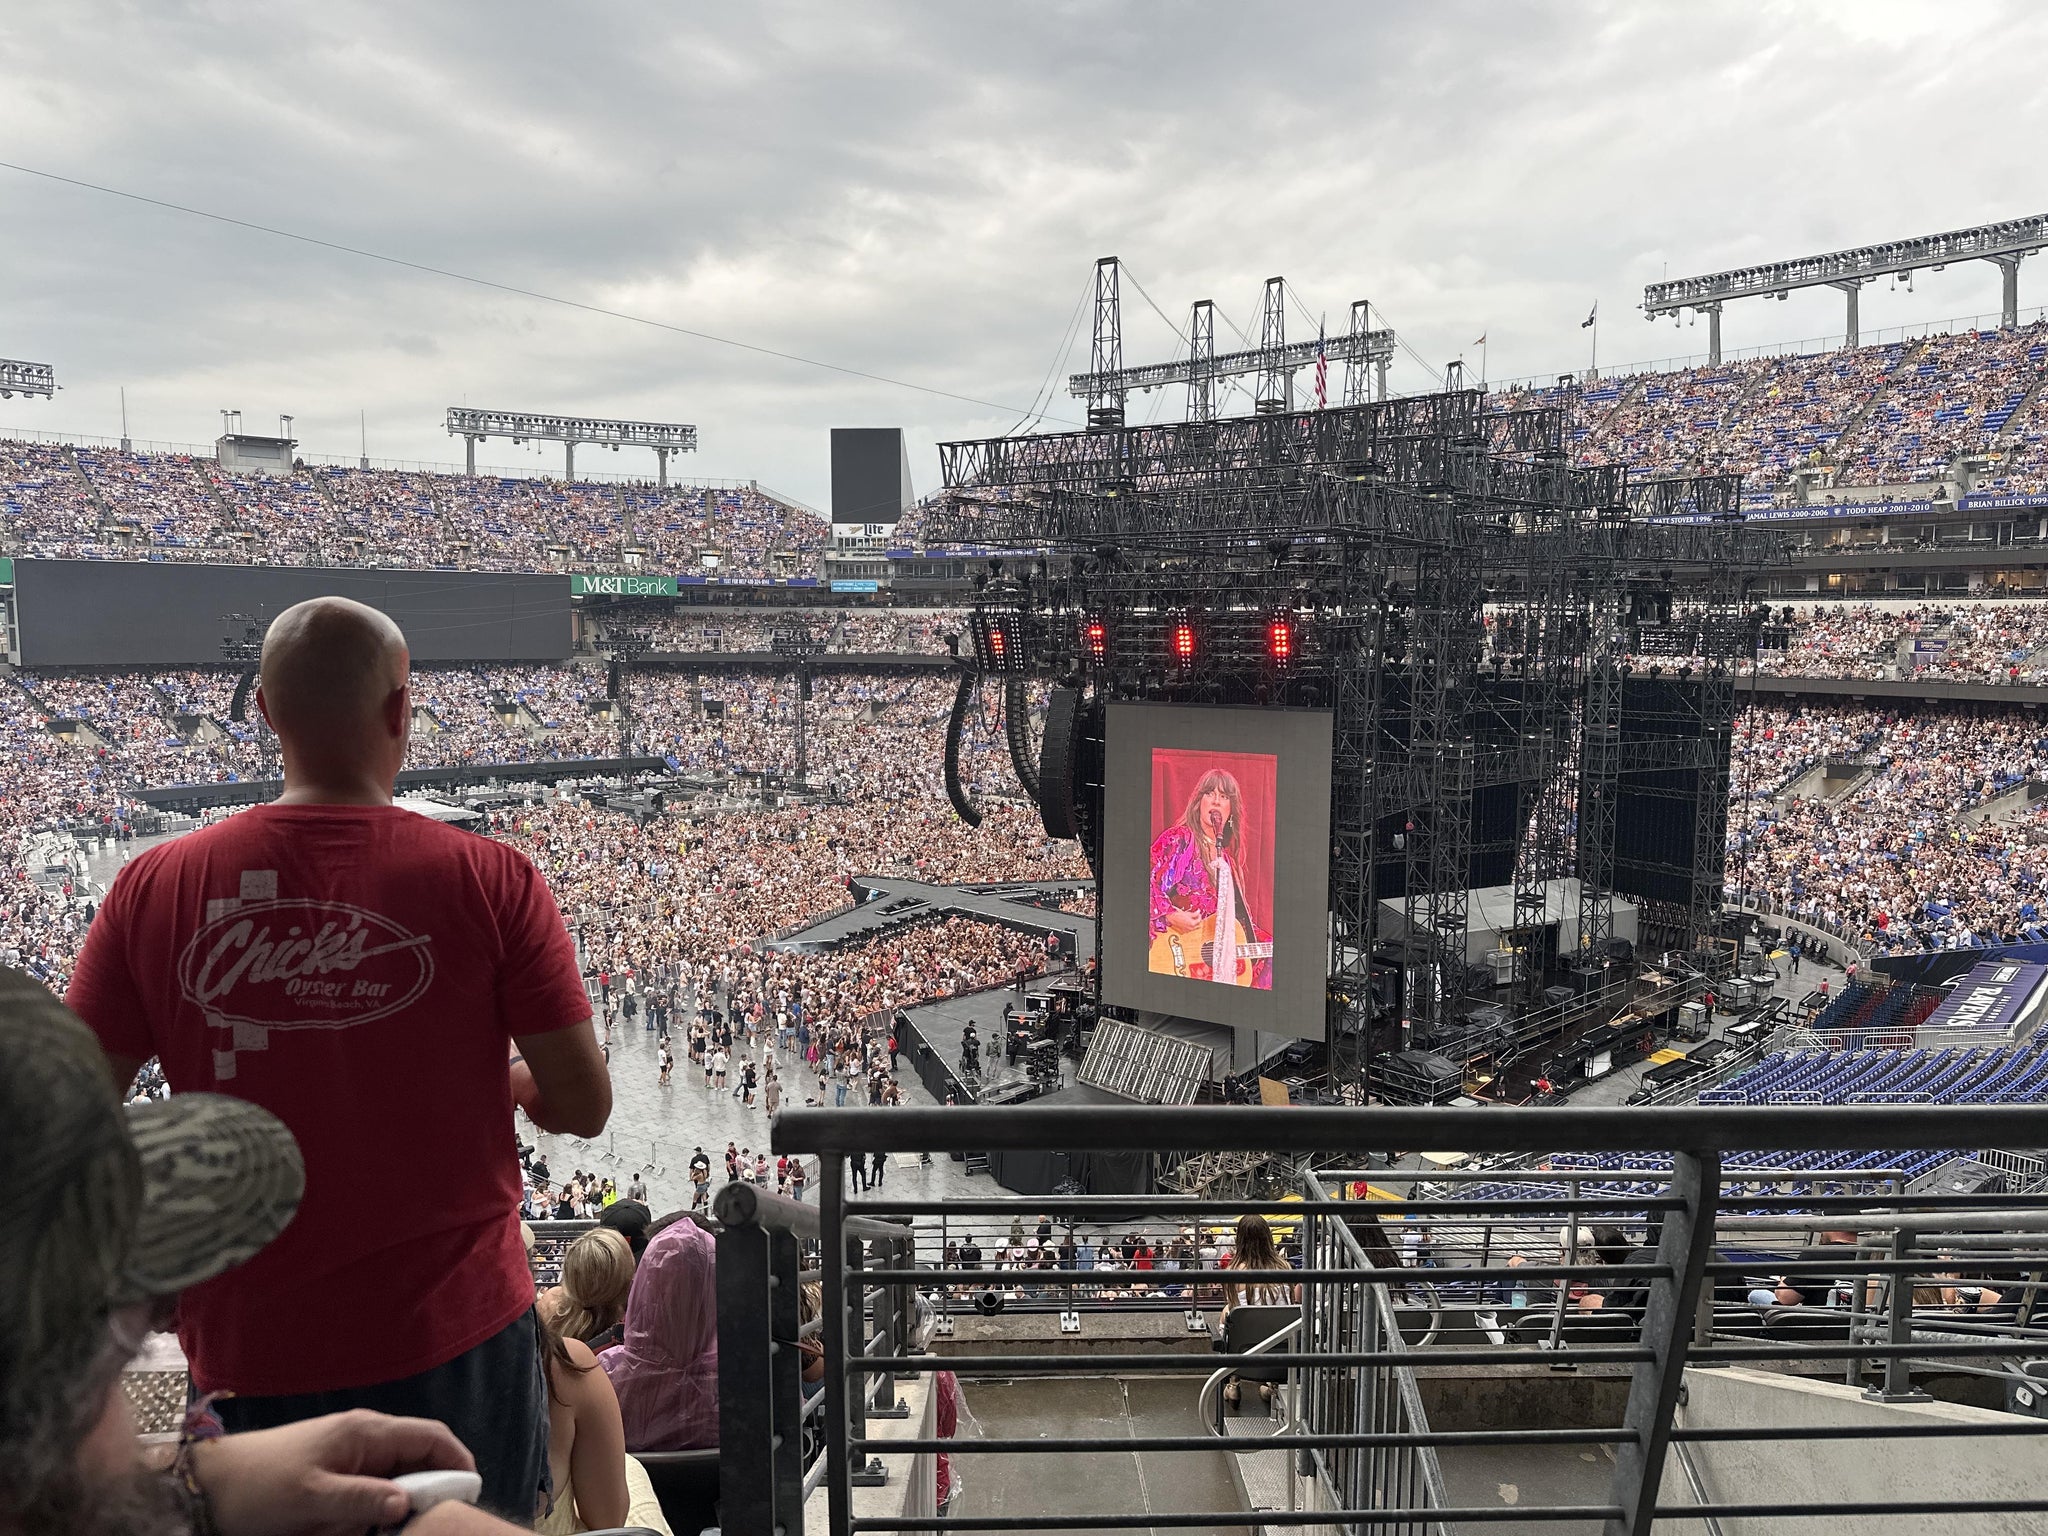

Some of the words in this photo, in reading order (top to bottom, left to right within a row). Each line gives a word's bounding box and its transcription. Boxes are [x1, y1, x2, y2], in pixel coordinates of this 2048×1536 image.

[1846, 507, 1866, 515] TODD
[1868, 506, 1888, 514] HEAP
[1889, 503, 1930, 513] 2001-2010
[1968, 500, 1993, 508] BRIAN
[1994, 498, 2026, 507] BILLICK
[1671, 516, 1694, 524] STOVER
[1747, 512, 1768, 521] JAMAL
[1769, 511, 1790, 519] LEWIS
[1791, 509, 1829, 518] 2000-2006
[864, 523, 884, 537] Lite
[582, 576, 626, 594] M&T
[627, 577, 668, 595] Bank
[195, 914, 431, 1004] Chick's
[351, 980, 392, 996] Bar
[1946, 986, 2004, 1027] RAVENS
